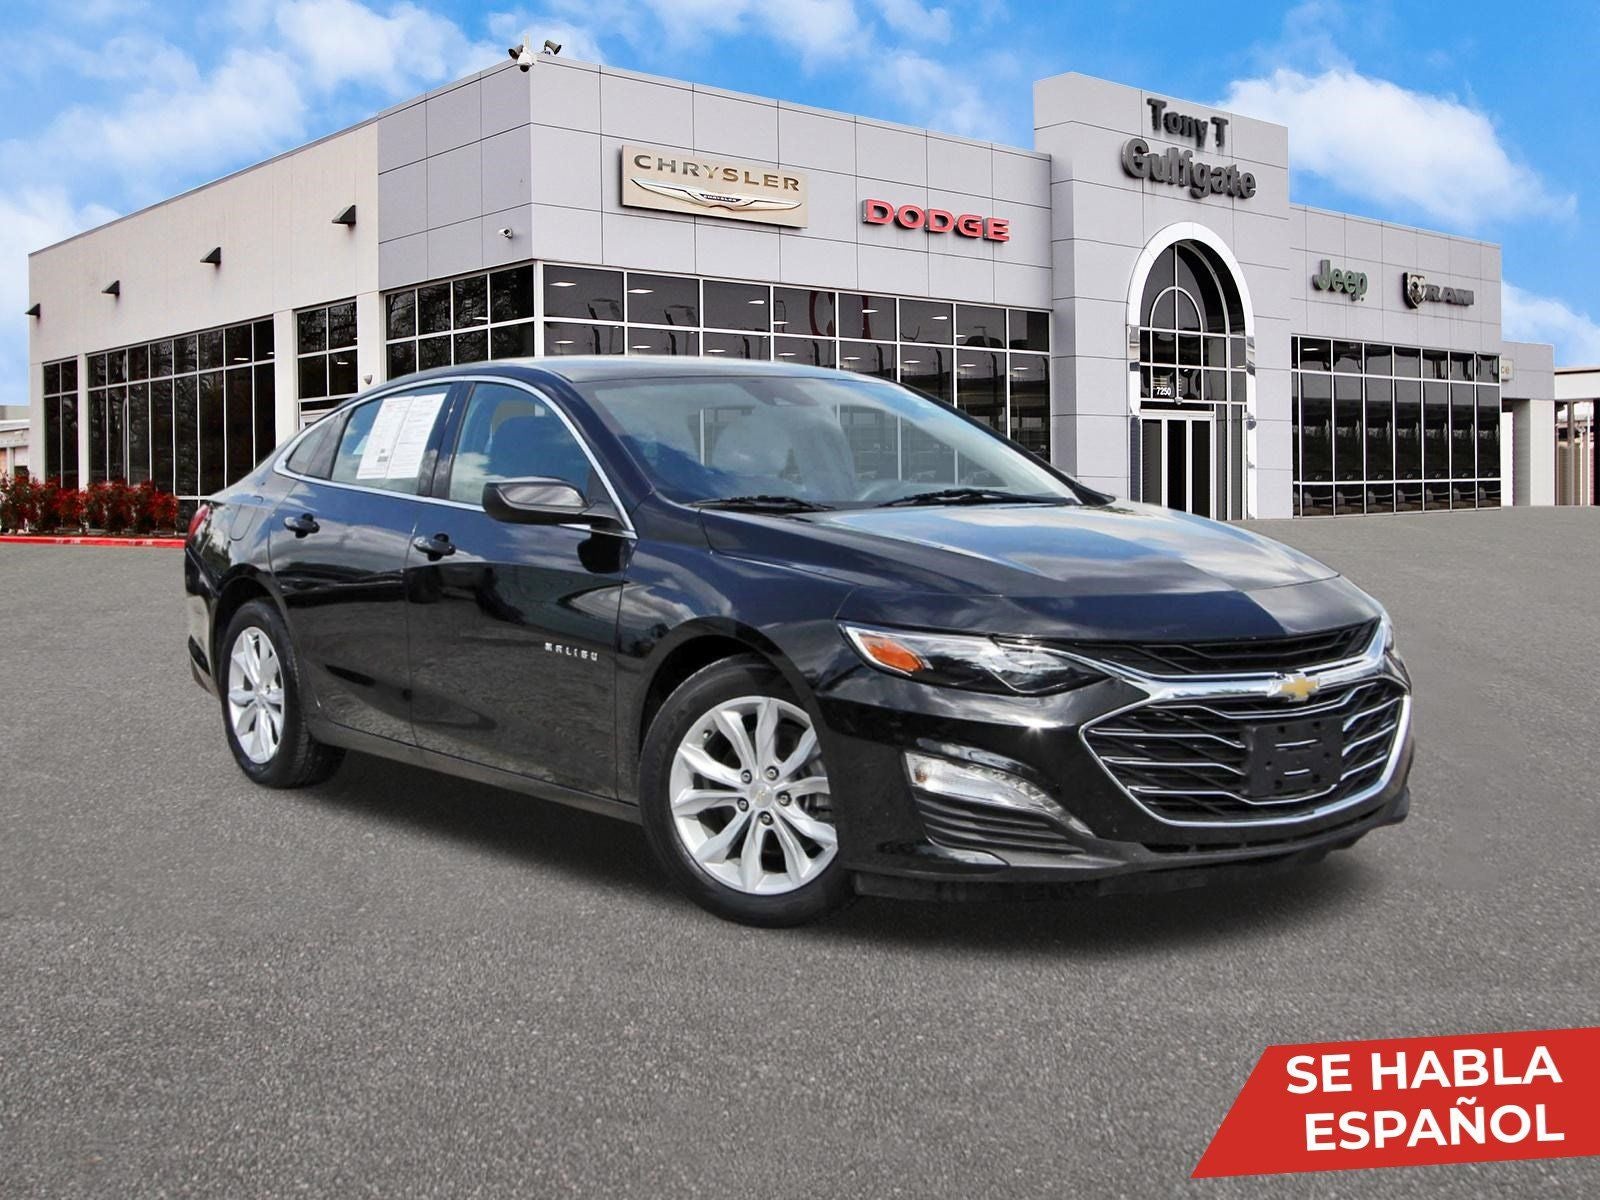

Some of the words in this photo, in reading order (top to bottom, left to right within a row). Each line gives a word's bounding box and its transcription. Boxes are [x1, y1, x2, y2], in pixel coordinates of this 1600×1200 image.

[1147, 98, 1208, 148] Tony
[1210, 116, 1229, 147] T
[633, 154, 800, 192] CHRYSLER
[1121, 138, 1256, 199] Gulfgate
[862, 199, 1010, 242] DODGE
[1312, 259, 1368, 302] Jeep
[1424, 283, 1474, 306] RAM
[1156, 386, 1172, 396] 7250
